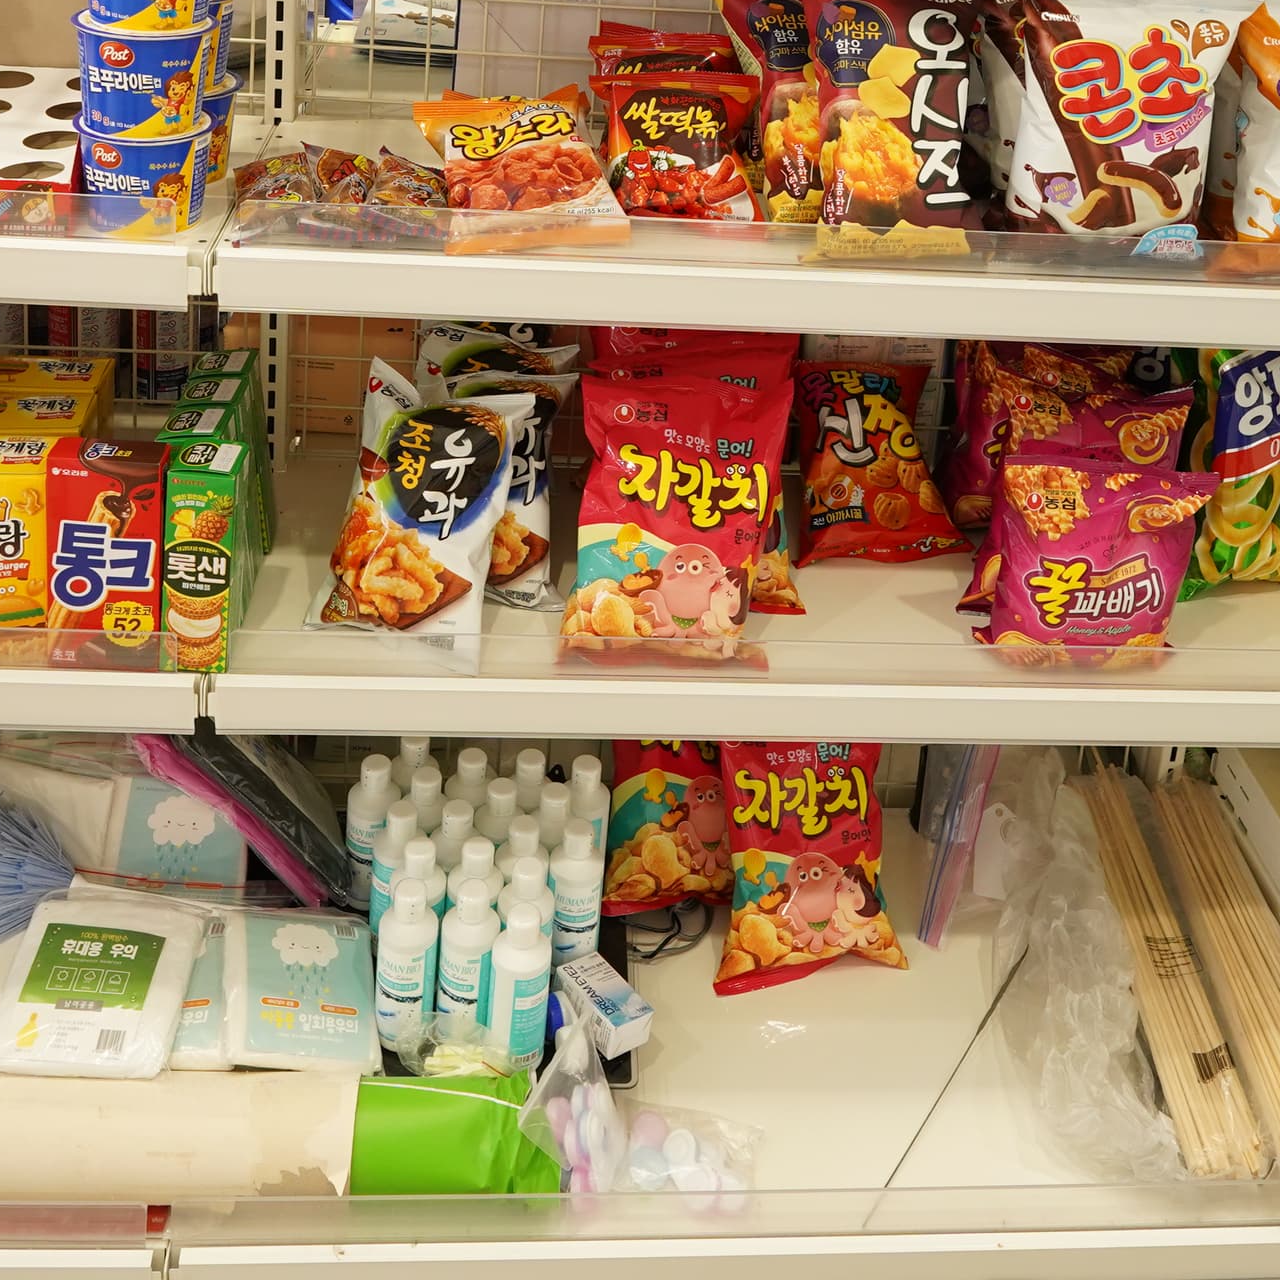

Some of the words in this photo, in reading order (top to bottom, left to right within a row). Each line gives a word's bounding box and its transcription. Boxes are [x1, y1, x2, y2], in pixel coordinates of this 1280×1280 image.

[772, 27, 800, 43] 함유
[835, 38, 864, 56] 함유
[102, 45, 131, 64] Post
[1056, 26, 1204, 140] 콘초
[450, 109, 576, 161] 왕소라
[93, 146, 118, 166] Post
[1032, 400, 1064, 417] 농심
[85, 441, 119, 460] 통크
[396, 419, 435, 491] 조청
[419, 427, 478, 541] 유과
[618, 443, 770, 529] 자갈치
[1044, 494, 1077, 511] 농심
[52, 519, 156, 611] 통크
[167, 552, 227, 586] 롯샌
[1029, 558, 1161, 625] 꿀꽈배기
[733, 765, 868, 838] 자갈치
[60, 940, 103, 958] 휴대용
[109, 943, 140, 960] 우의
[588, 985, 616, 1018] DREAM
